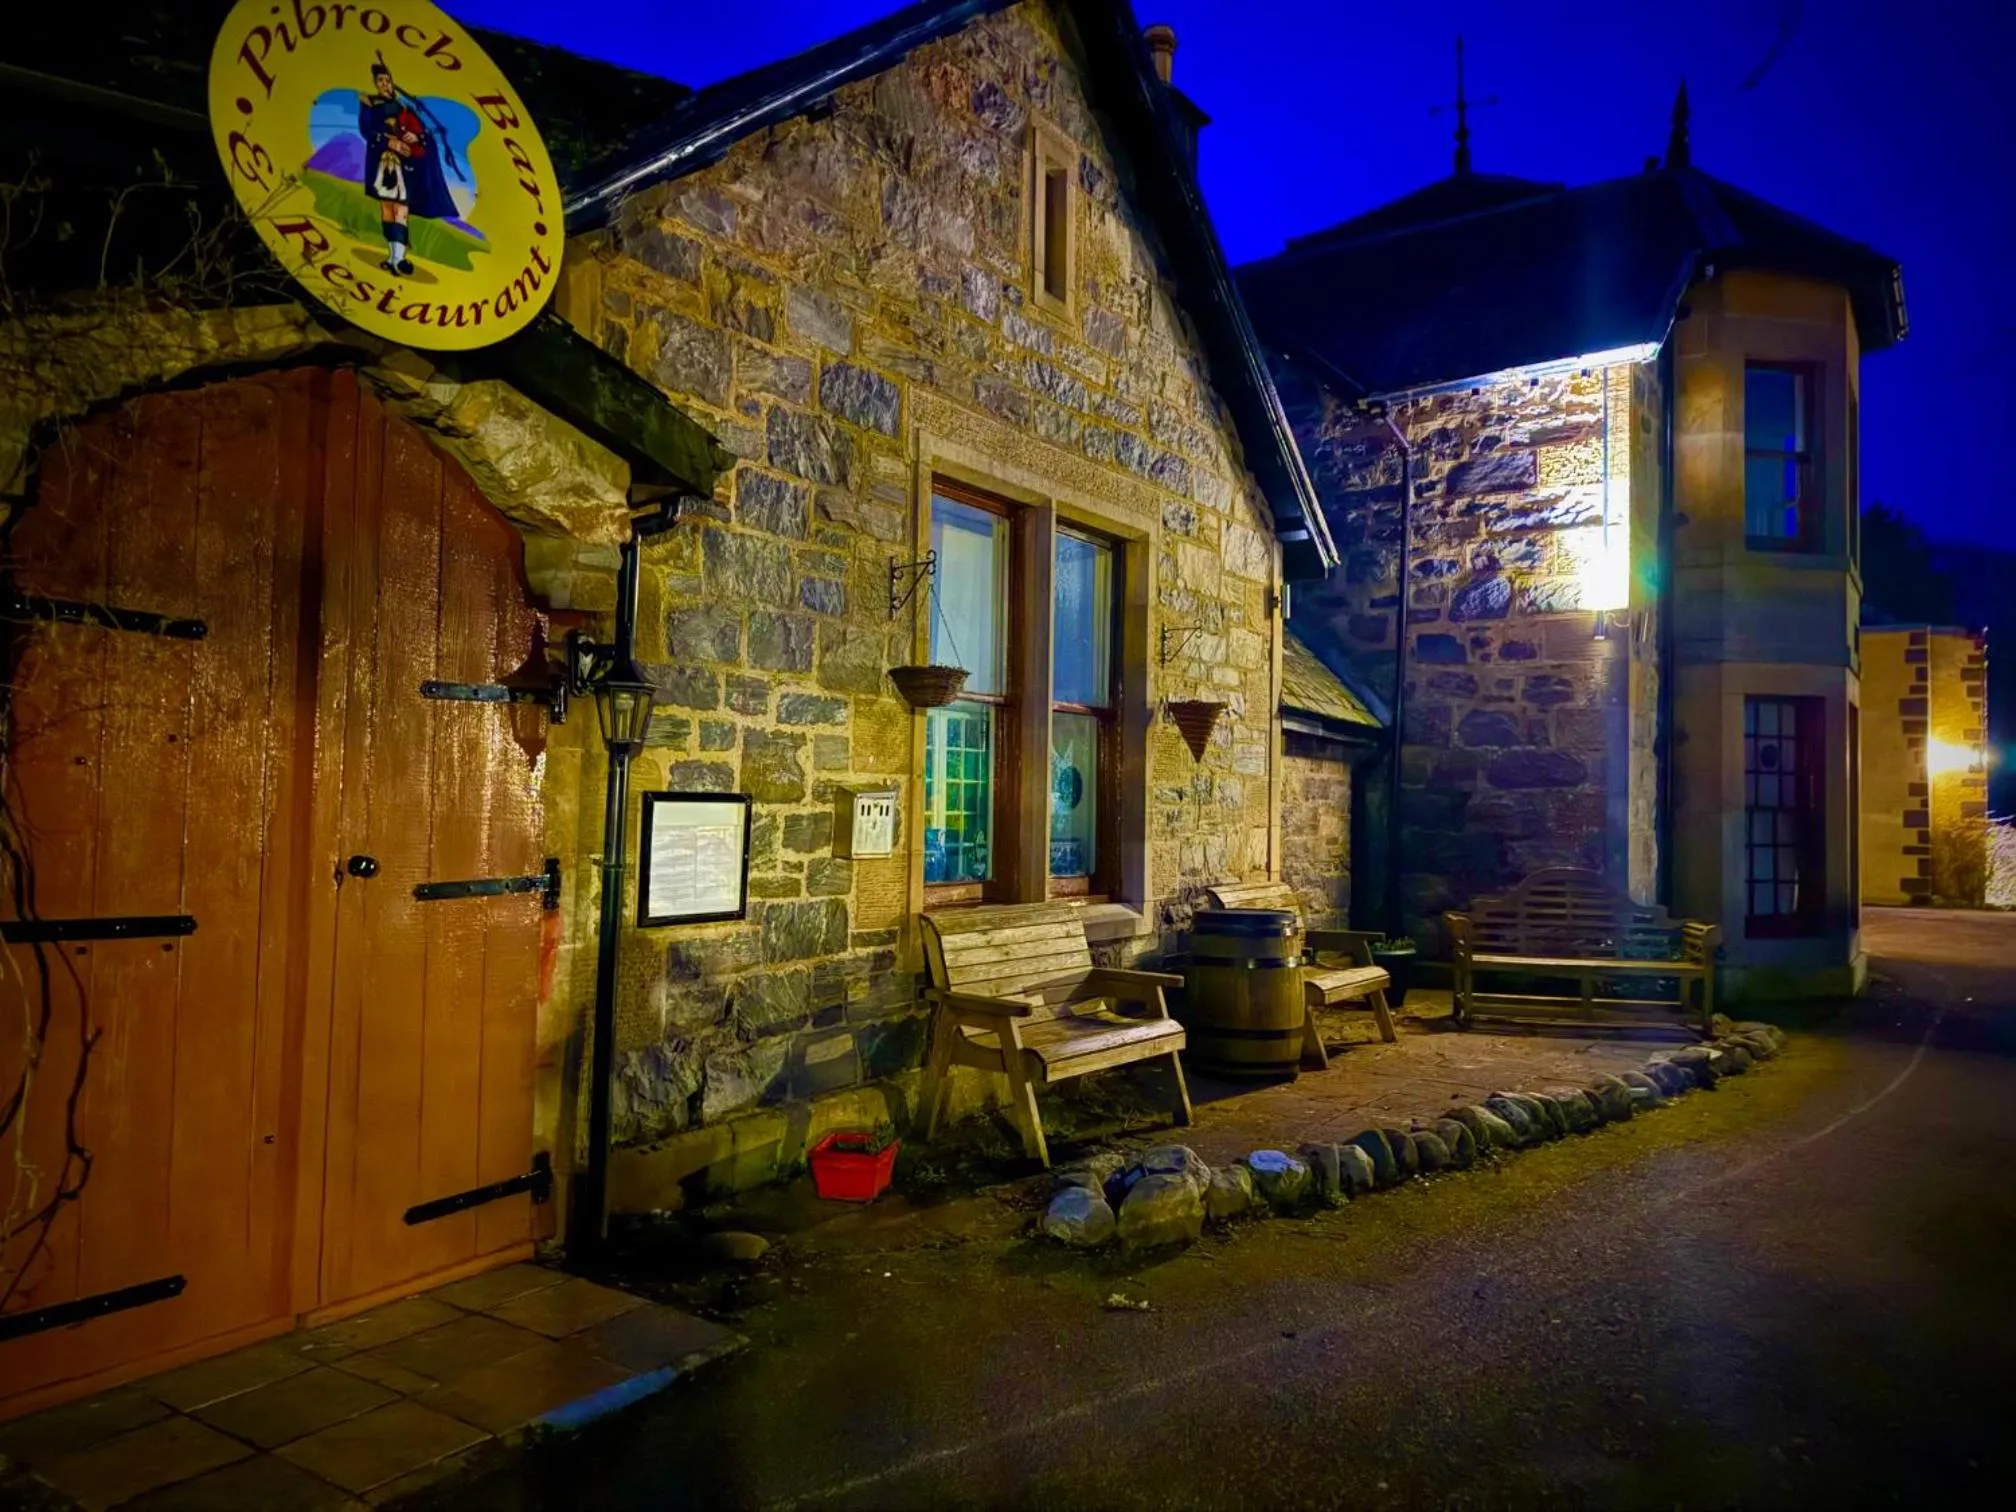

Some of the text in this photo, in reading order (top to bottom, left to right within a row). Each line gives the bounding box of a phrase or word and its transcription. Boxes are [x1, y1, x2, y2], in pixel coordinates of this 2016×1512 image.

[238, 0, 544, 215] Pibroch Bar
[228, 130, 552, 328] & Restaurant
